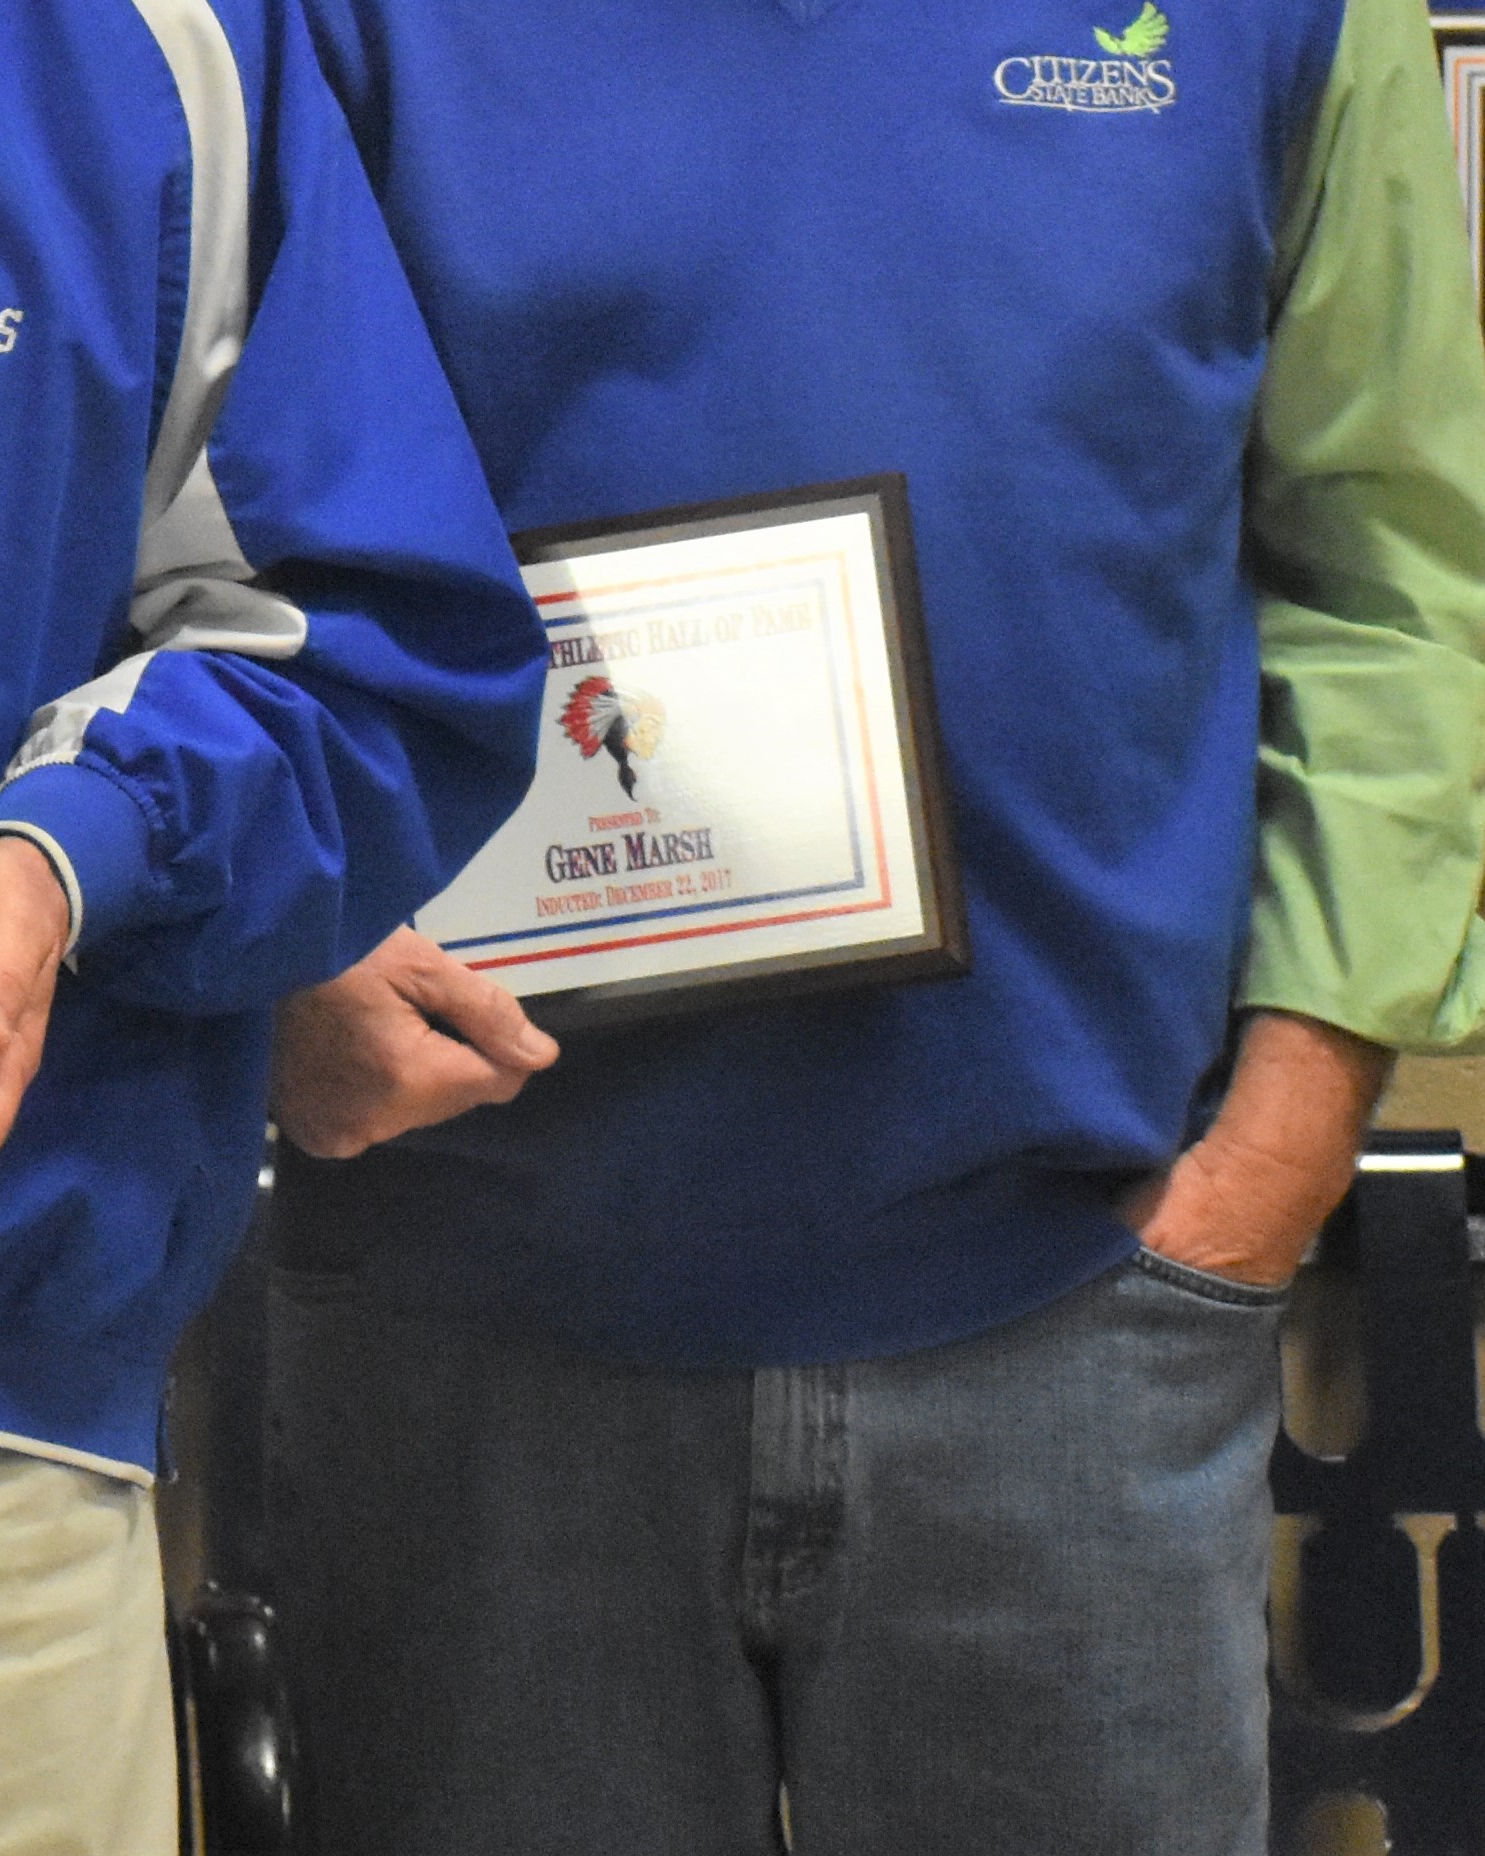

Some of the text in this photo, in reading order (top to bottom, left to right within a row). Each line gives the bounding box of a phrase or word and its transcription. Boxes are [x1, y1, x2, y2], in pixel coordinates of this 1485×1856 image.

[993, 56, 1177, 104] CITIZENS
[1032, 84, 1161, 114] STATE BANK
[546, 601, 812, 672] THLETIC HALL OF FAME
[545, 827, 713, 885] GENE MARSH
[535, 889, 602, 918] INDUCTED:
[606, 879, 674, 910] DECEMBER
[701, 868, 733, 893] 2017
